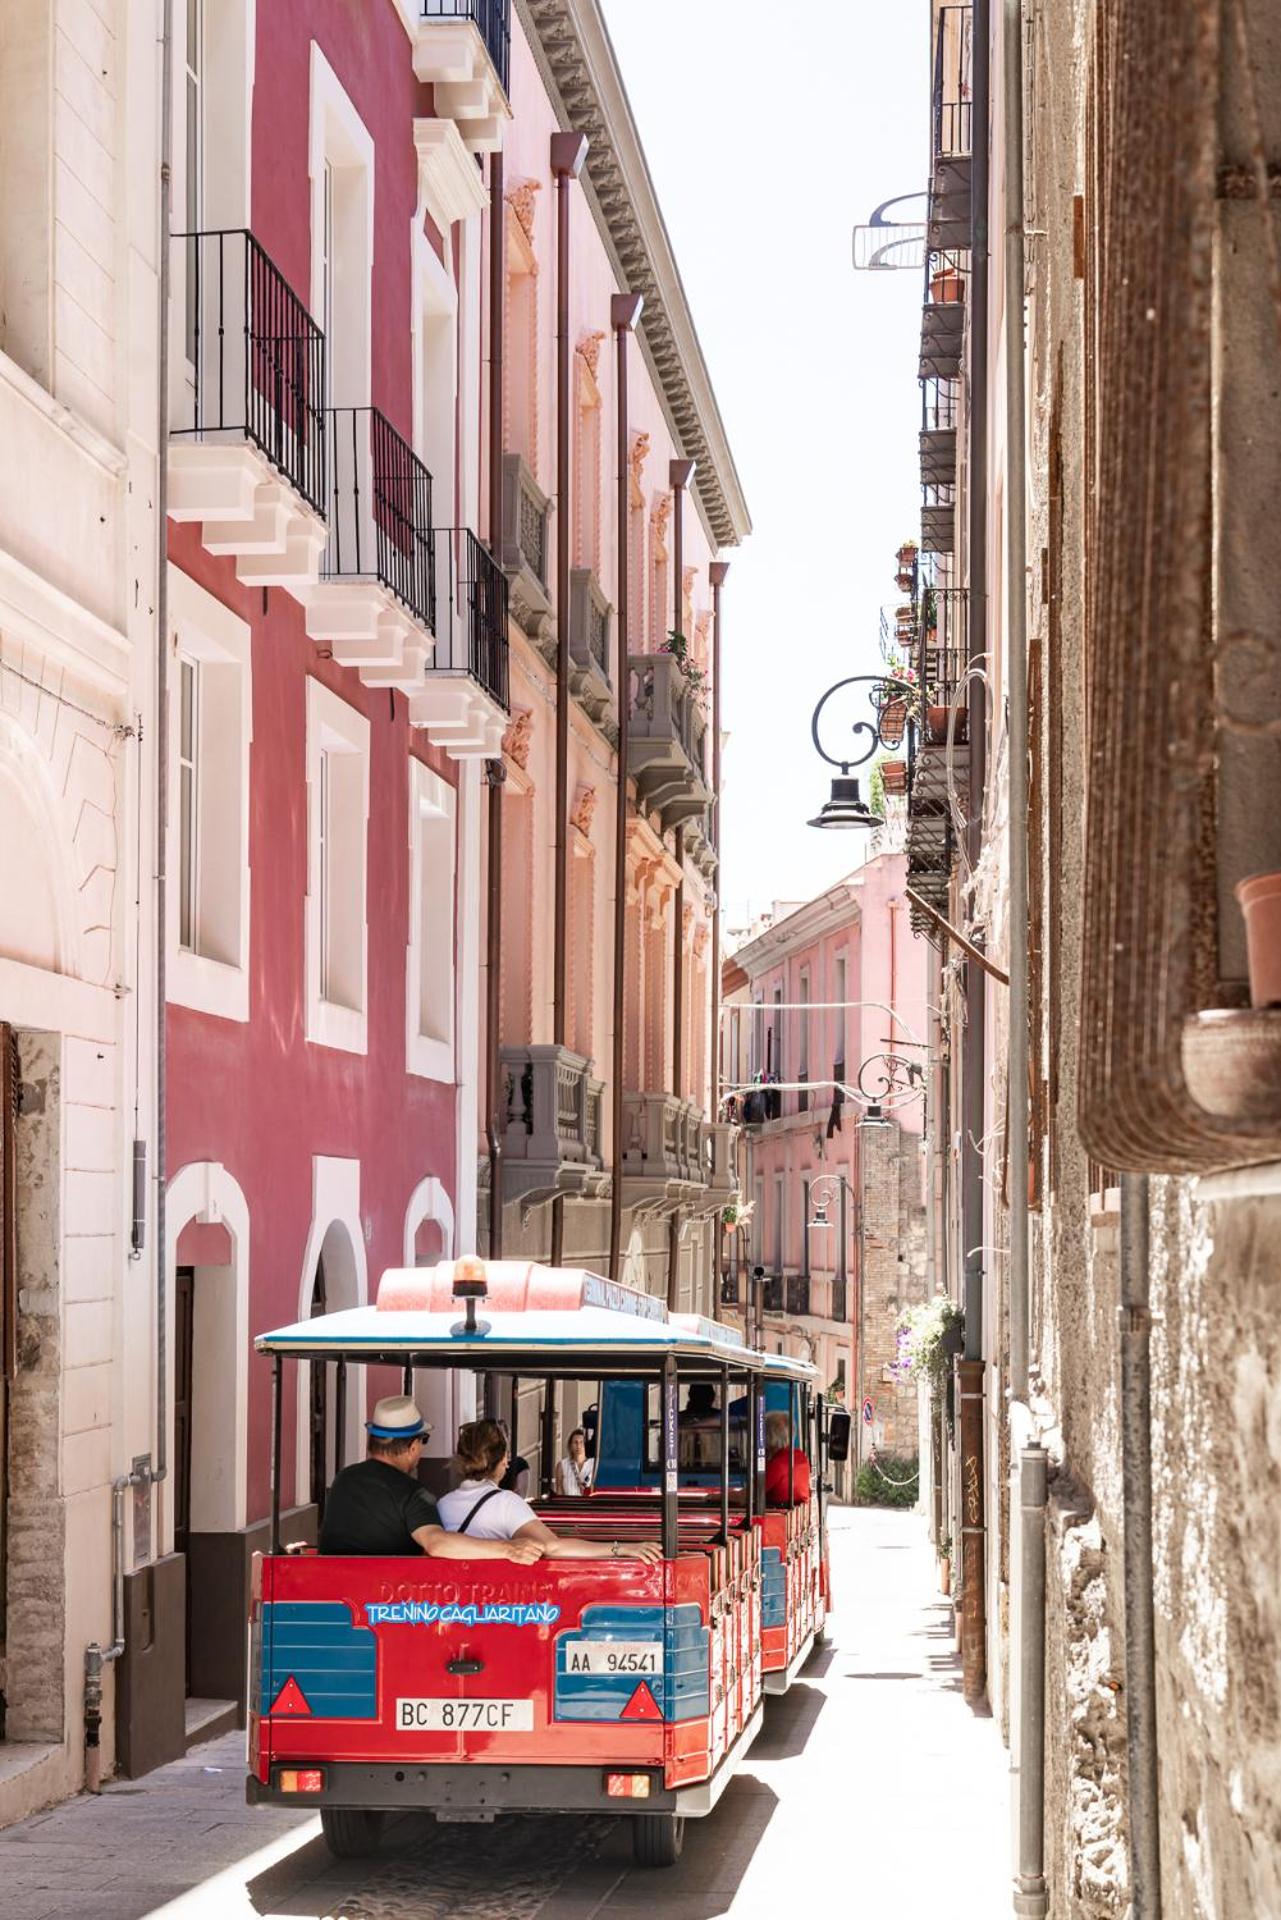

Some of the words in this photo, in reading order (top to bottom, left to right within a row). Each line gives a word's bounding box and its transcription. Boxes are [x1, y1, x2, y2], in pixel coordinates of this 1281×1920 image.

[667, 1384, 675, 1456] TICKET
[366, 1603, 438, 1626] TRENINO
[440, 1603, 559, 1626] CAGLIARITANO
[571, 1653, 590, 1672] AA
[607, 1653, 656, 1672] 94541
[401, 1703, 428, 1727] BC
[442, 1703, 514, 1727] 877CF
